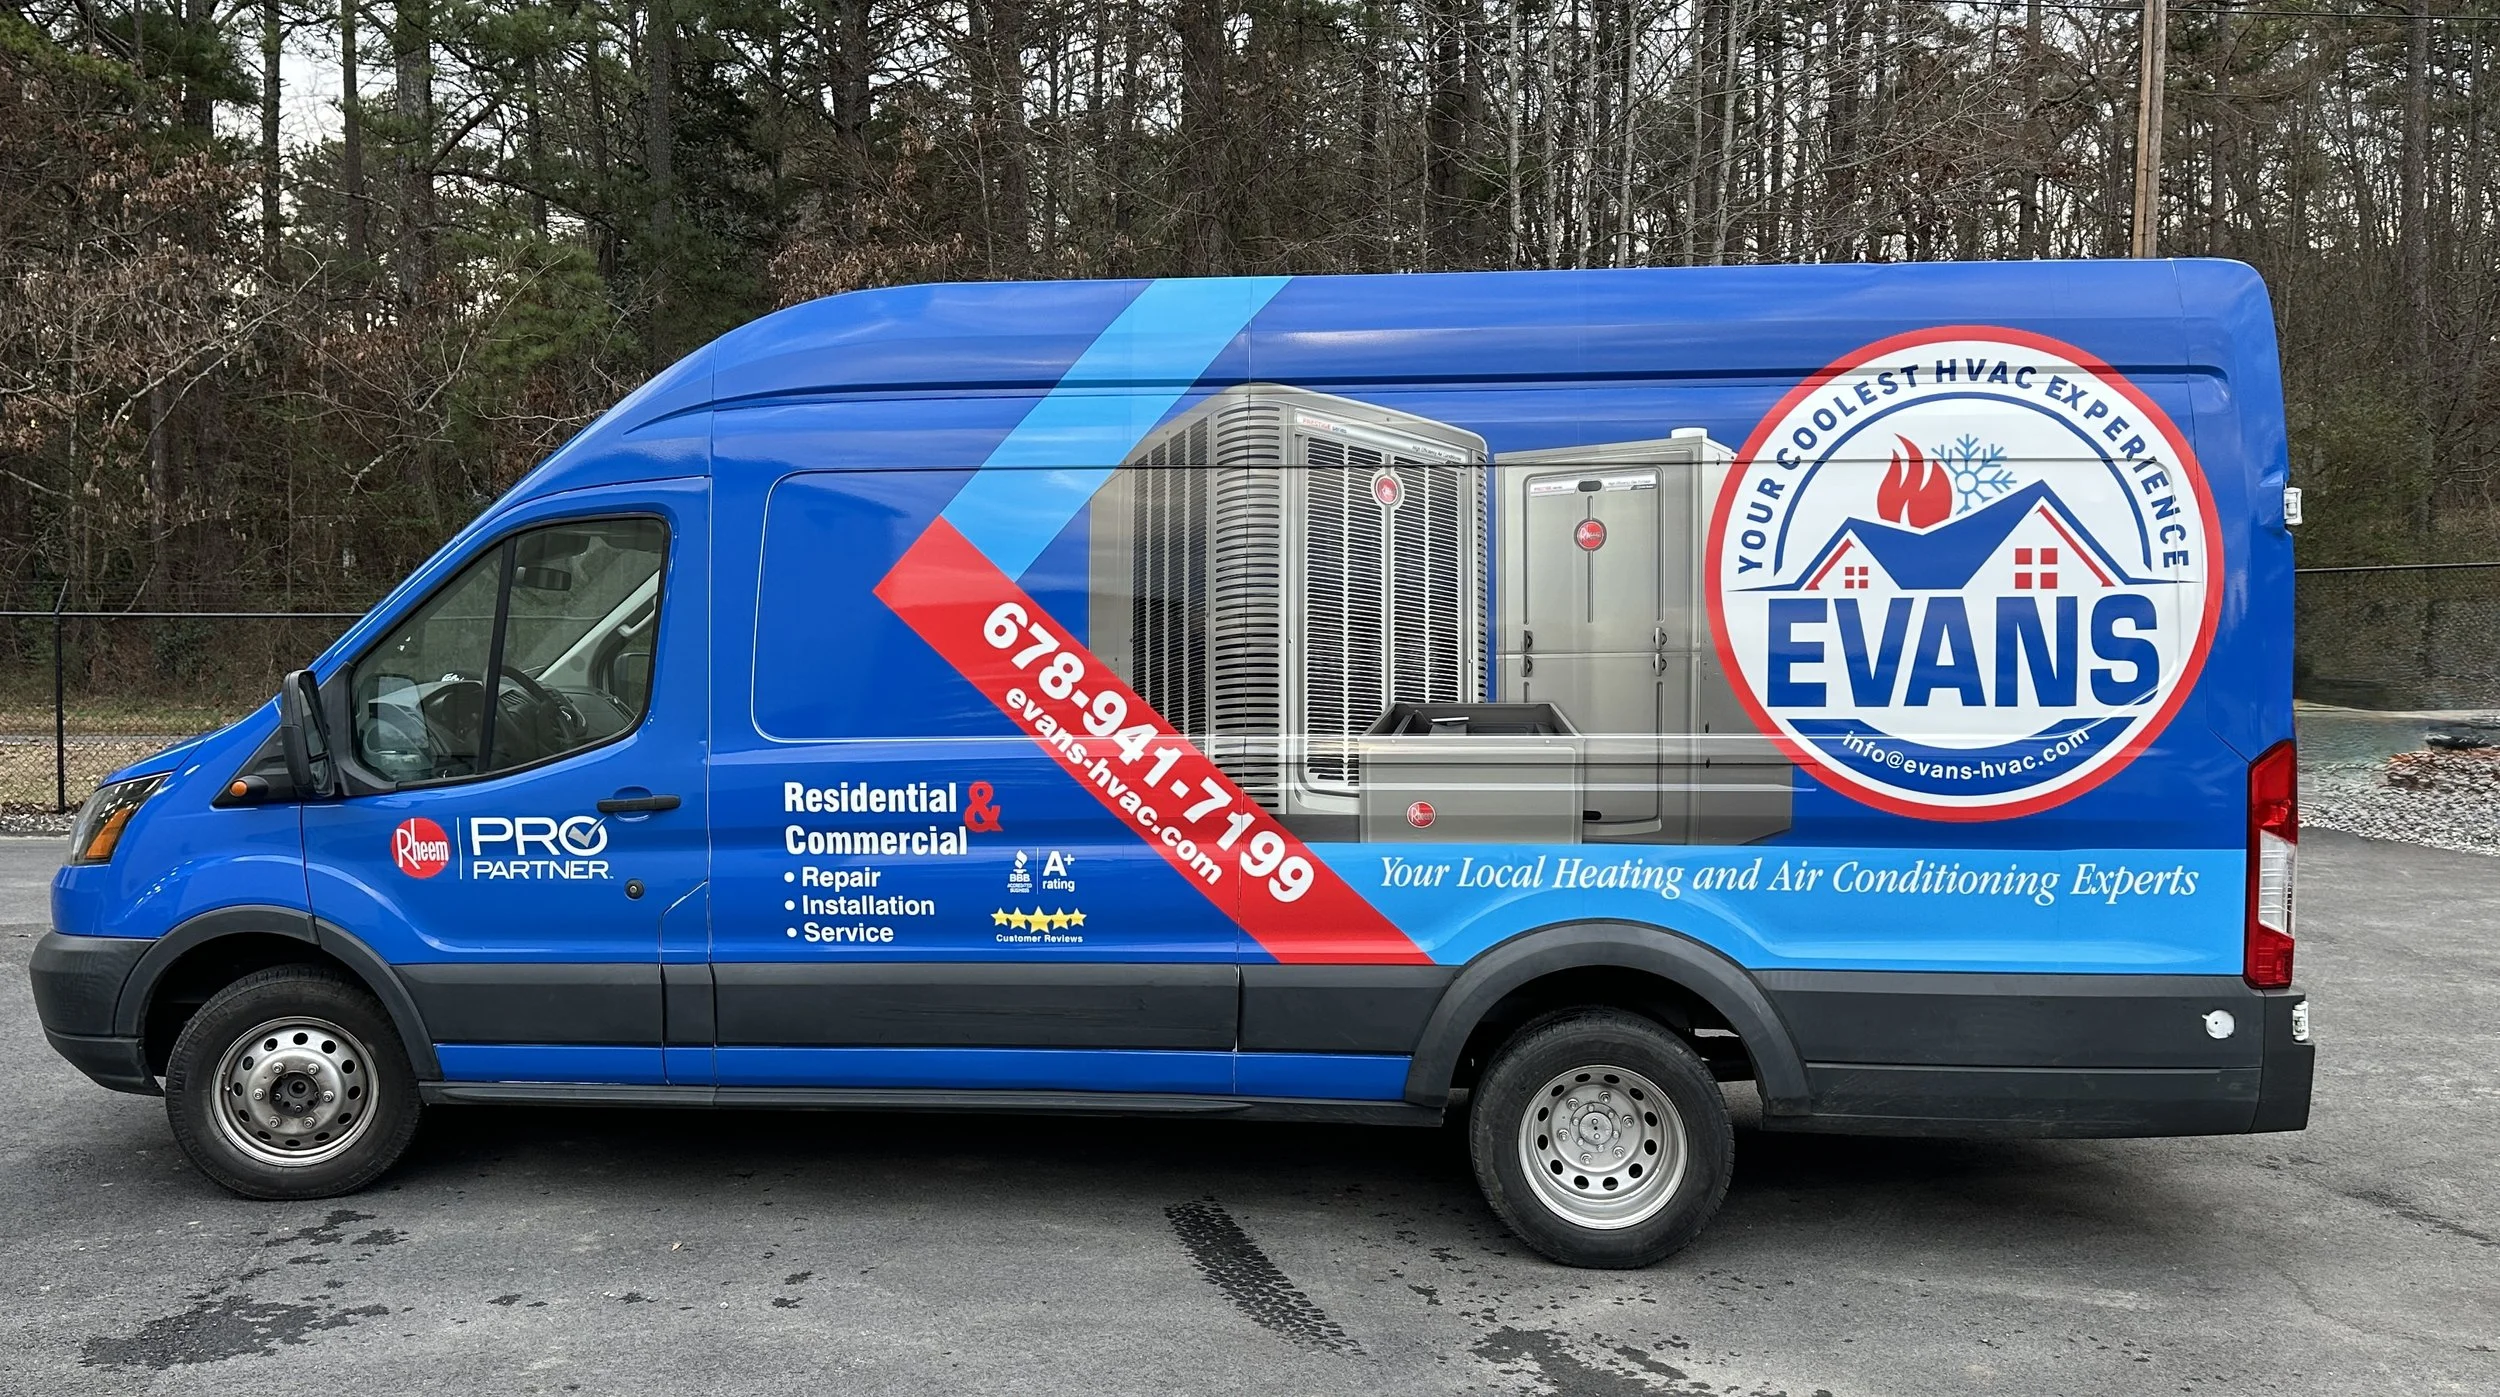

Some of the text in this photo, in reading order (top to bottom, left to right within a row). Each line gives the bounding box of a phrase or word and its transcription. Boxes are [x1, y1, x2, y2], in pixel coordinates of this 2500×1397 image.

[1738, 358, 2189, 574] YOUR COOLEST HVAC EXPERIENCE
[1767, 594, 2160, 708] EVANS
[983, 602, 1315, 903] 678-941-7199
[1841, 729, 2091, 780] info@evans-hvac.com
[1006, 687, 1223, 885] evans-hvac.com
[784, 780, 1003, 833] Residential &
[396, 817, 449, 870] Rheem
[470, 815, 608, 857] PRO
[785, 825, 968, 855] Commercial
[473, 860, 609, 880] PARTNER
[801, 867, 881, 892] Repair
[1009, 873, 1031, 883] BBB
[1042, 850, 1076, 877] A+
[1380, 855, 2200, 907] Your Local Heating and Air Conditioning Experts
[1042, 878, 1075, 893] rating
[801, 895, 935, 916] Installation
[803, 921, 894, 943] Service
[995, 933, 1084, 944] Customer Reviews
